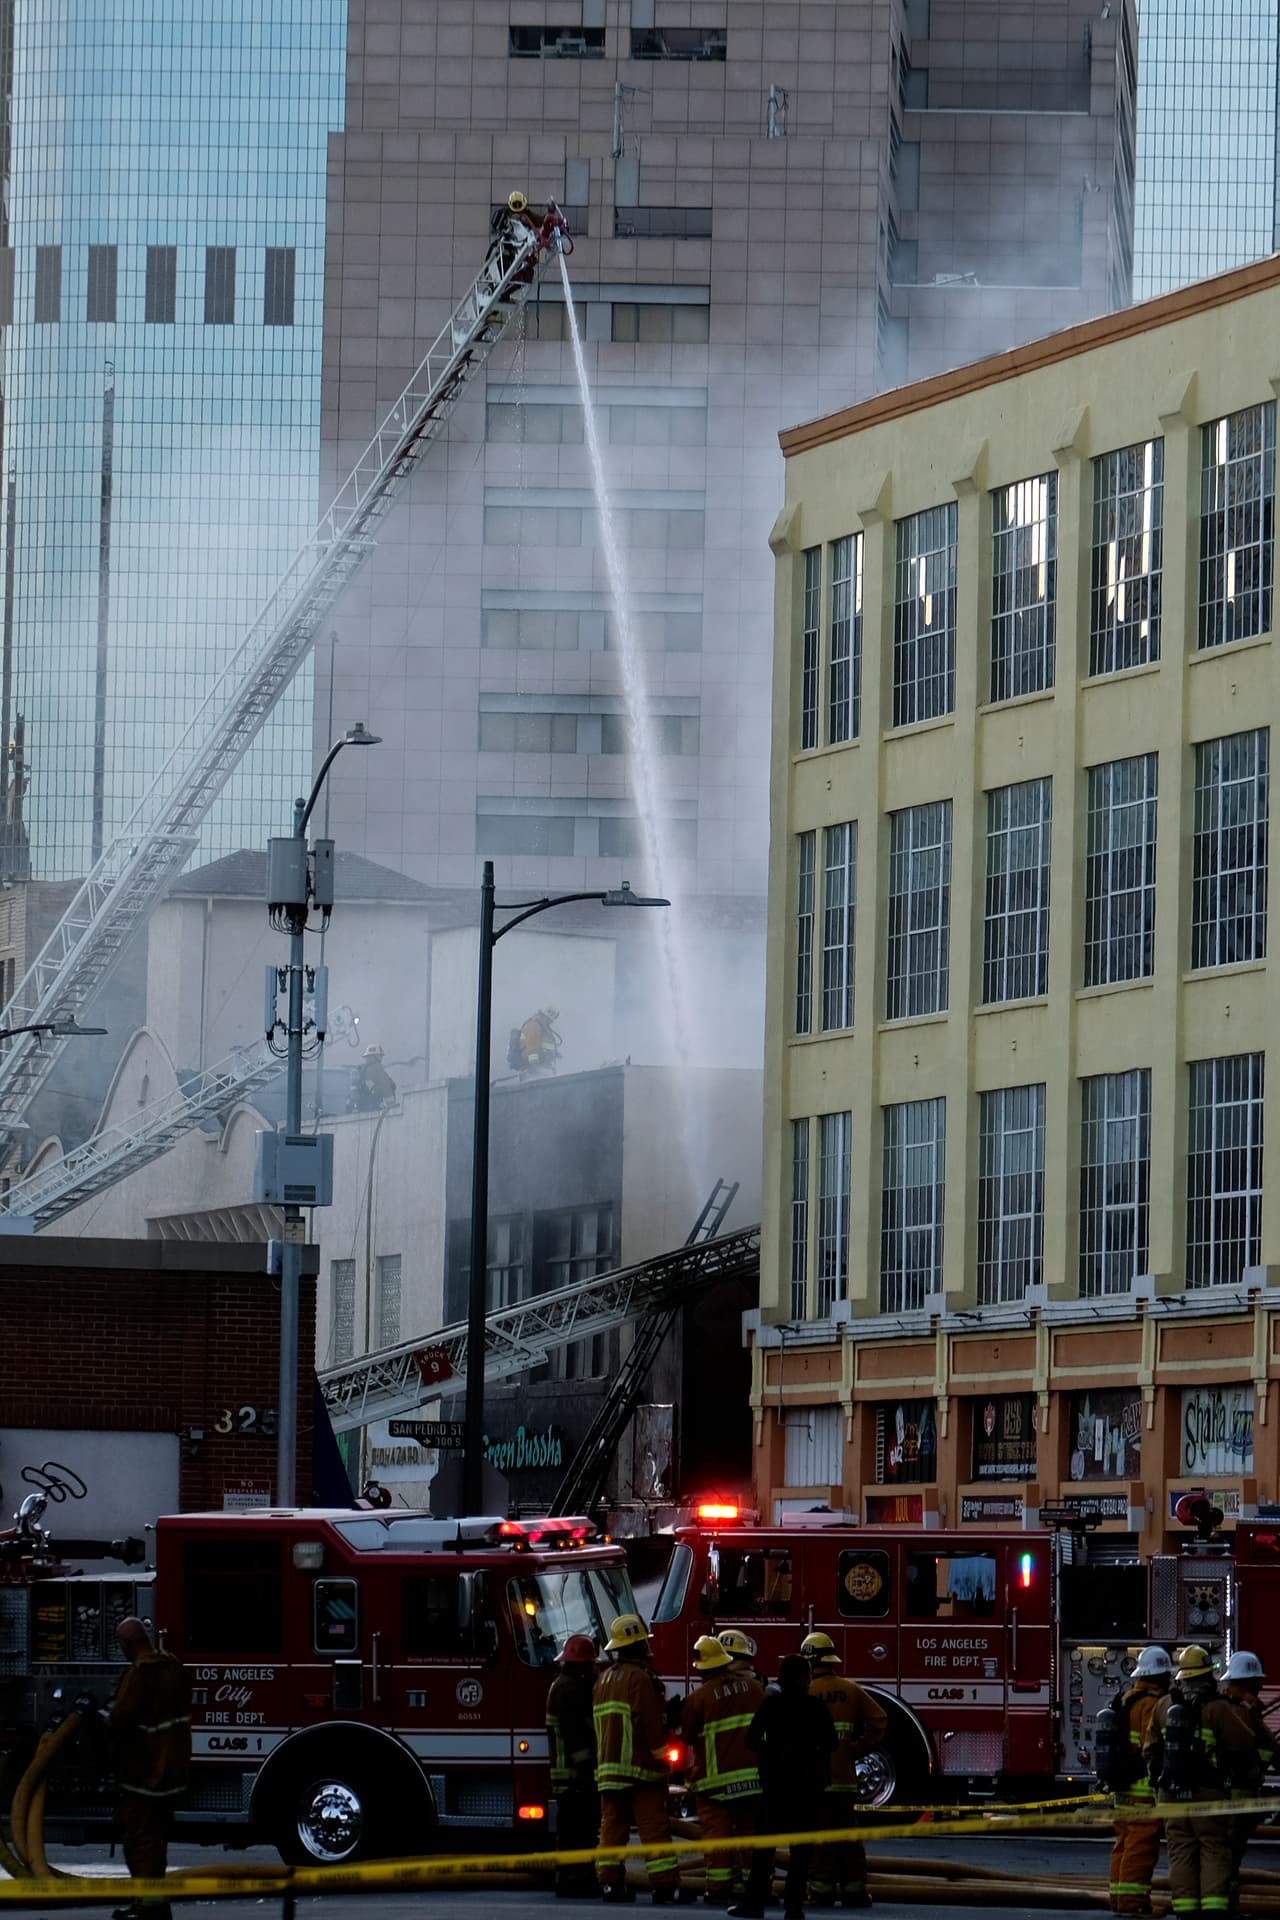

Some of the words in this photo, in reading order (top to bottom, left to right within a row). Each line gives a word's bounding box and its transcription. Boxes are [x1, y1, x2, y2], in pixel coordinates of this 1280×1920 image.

[430, 1360, 440, 1374] 9
[214, 1406, 280, 1435] 325
[392, 1422, 413, 1435] SAN
[414, 1423, 447, 1436] PEDRO
[515, 1424, 562, 1469] Buddha
[240, 1480, 254, 1488] NO
[916, 1638, 937, 1649] LOS
[941, 1638, 989, 1650] ANGELES
[924, 1655, 948, 1667] FIRE
[952, 1655, 981, 1667] DEPT.
[195, 1667, 219, 1681] LOS
[223, 1668, 275, 1681] ANGELES
[214, 1684, 253, 1709] City
[714, 1680, 750, 1700] LAFD
[927, 1688, 964, 1700] CLASS
[972, 1688, 977, 1700] 1
[205, 1711, 230, 1724] FIRE
[236, 1711, 267, 1725] DEPT.
[208, 1737, 248, 1750] CLASS
[256, 1737, 263, 1751] 1
